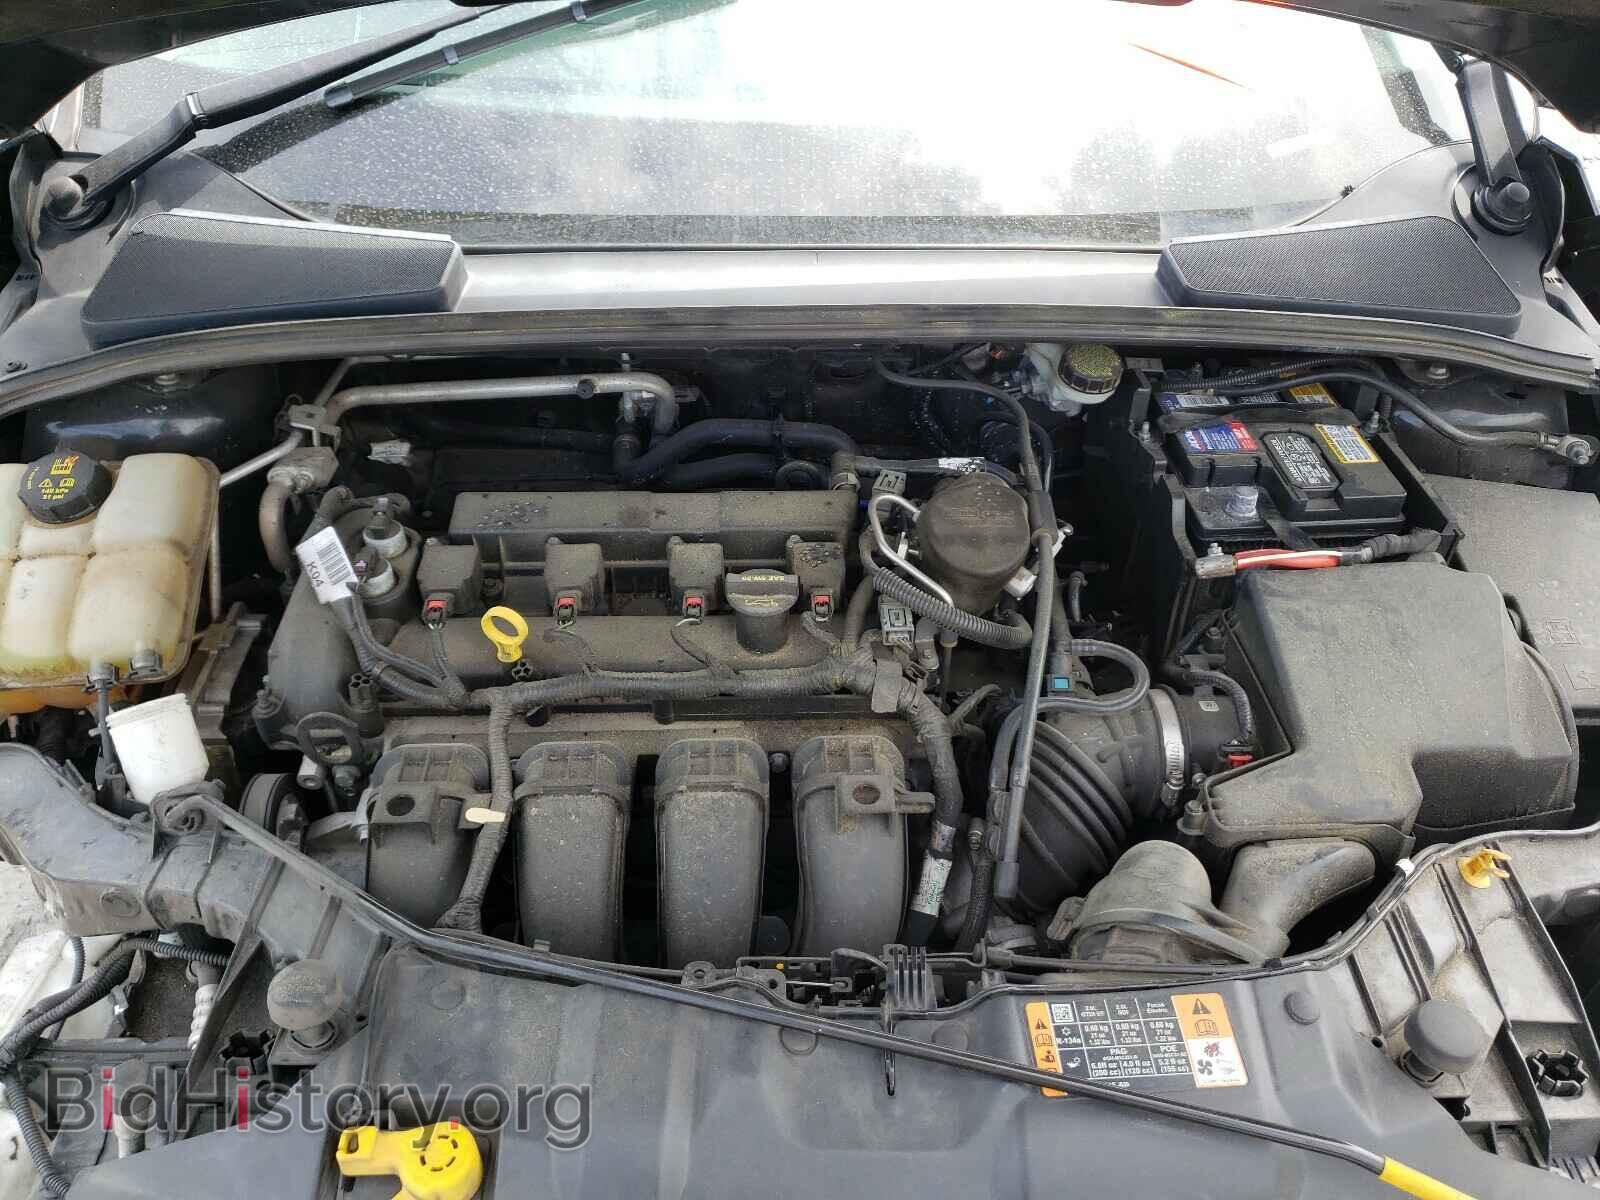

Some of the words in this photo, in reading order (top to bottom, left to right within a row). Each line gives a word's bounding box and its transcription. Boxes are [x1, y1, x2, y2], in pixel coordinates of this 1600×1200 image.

[306, 561, 325, 588] K04
[1100, 1025, 1109, 1033] kg
[1056, 1036, 1081, 1044] R-134a
